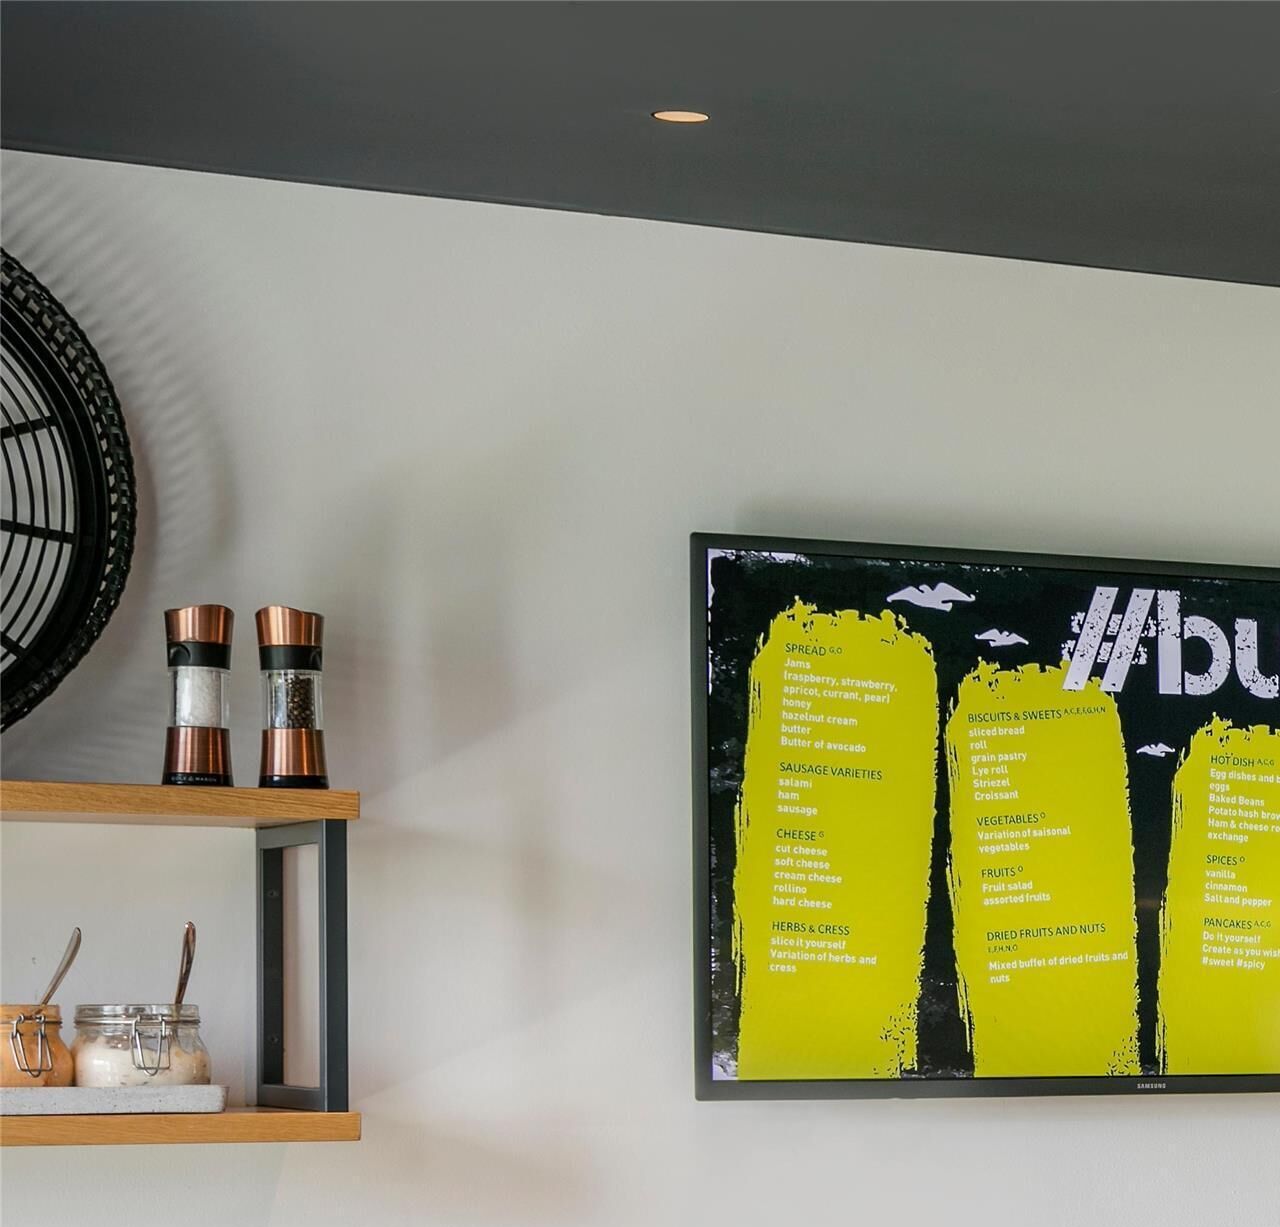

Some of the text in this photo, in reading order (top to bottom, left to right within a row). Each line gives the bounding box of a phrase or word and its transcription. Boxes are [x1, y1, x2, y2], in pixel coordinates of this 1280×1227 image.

[785, 643, 827, 656] SPREAD
[784, 658, 811, 670] Jams
[783, 698, 811, 710] honey
[782, 711, 858, 727] hazelnut cream
[968, 709, 1062, 723] BISCUITS & SWEETS
[781, 724, 811, 735] butter
[969, 725, 1025, 737] sliced bread
[781, 736, 866, 753] Butter of avocado
[970, 740, 987, 750] roll
[971, 751, 1027, 763] grain pastry
[1211, 756, 1254, 767] HOT DISH
[780, 762, 883, 780] SAUSAGE VARIETIES
[972, 765, 1008, 775] Lye roll
[1210, 769, 1227, 781] Egg
[1229, 771, 1256, 782] dishes
[1258, 774, 1274, 783] and
[778, 778, 813, 789] salami
[973, 778, 1010, 788] Striezel
[1209, 783, 1230, 792] eggs
[778, 790, 799, 801] ham
[975, 790, 1018, 801] Croissant
[1209, 794, 1265, 806] Baked Beans
[777, 804, 818, 817] sausage
[1209, 806, 1237, 816] Potato
[1238, 808, 1259, 818] hash
[977, 814, 1039, 826] VEGETABLES
[1208, 818, 1228, 828] Ham
[1230, 820, 1236, 829] &
[1239, 821, 1268, 831] cheese
[777, 828, 816, 841] CHEESE
[978, 829, 1022, 840] Variation
[1022, 828, 1031, 837] of
[1208, 832, 1248, 843] exchange
[775, 844, 828, 857] cut cheese
[979, 842, 1029, 854] vegetables
[775, 856, 830, 870] soft cheese
[1206, 854, 1237, 865] SPICES
[774, 870, 842, 884] cream cheese
[981, 867, 1015, 878] FRUITS
[1206, 868, 1235, 879] vanilla
[983, 881, 1032, 893] Fruit salad
[1205, 881, 1248, 892] cinnamon
[773, 896, 833, 909] hard cheese
[983, 893, 1050, 905] assorted fruits
[1204, 894, 1272, 907] Salt and pepper
[772, 921, 850, 935] HERBS & CRESS
[1204, 918, 1252, 929] PANCAKES
[987, 923, 1105, 942] DRIED FRUITS AND NUTS
[1203, 931, 1214, 941] Do
[1224, 932, 1261, 943] yourself
[771, 936, 795, 946] slice
[805, 938, 846, 950] yourself
[1202, 944, 1232, 954] Create
[1233, 946, 1243, 955] as
[1245, 948, 1260, 957] you
[770, 949, 877, 965] Variation of herbs and
[989, 951, 1128, 970] Mixed buffet of dried fruits and
[1202, 956, 1265, 970] #sweet #spicy
[770, 962, 797, 973] cress
[990, 974, 1010, 984] nuts
